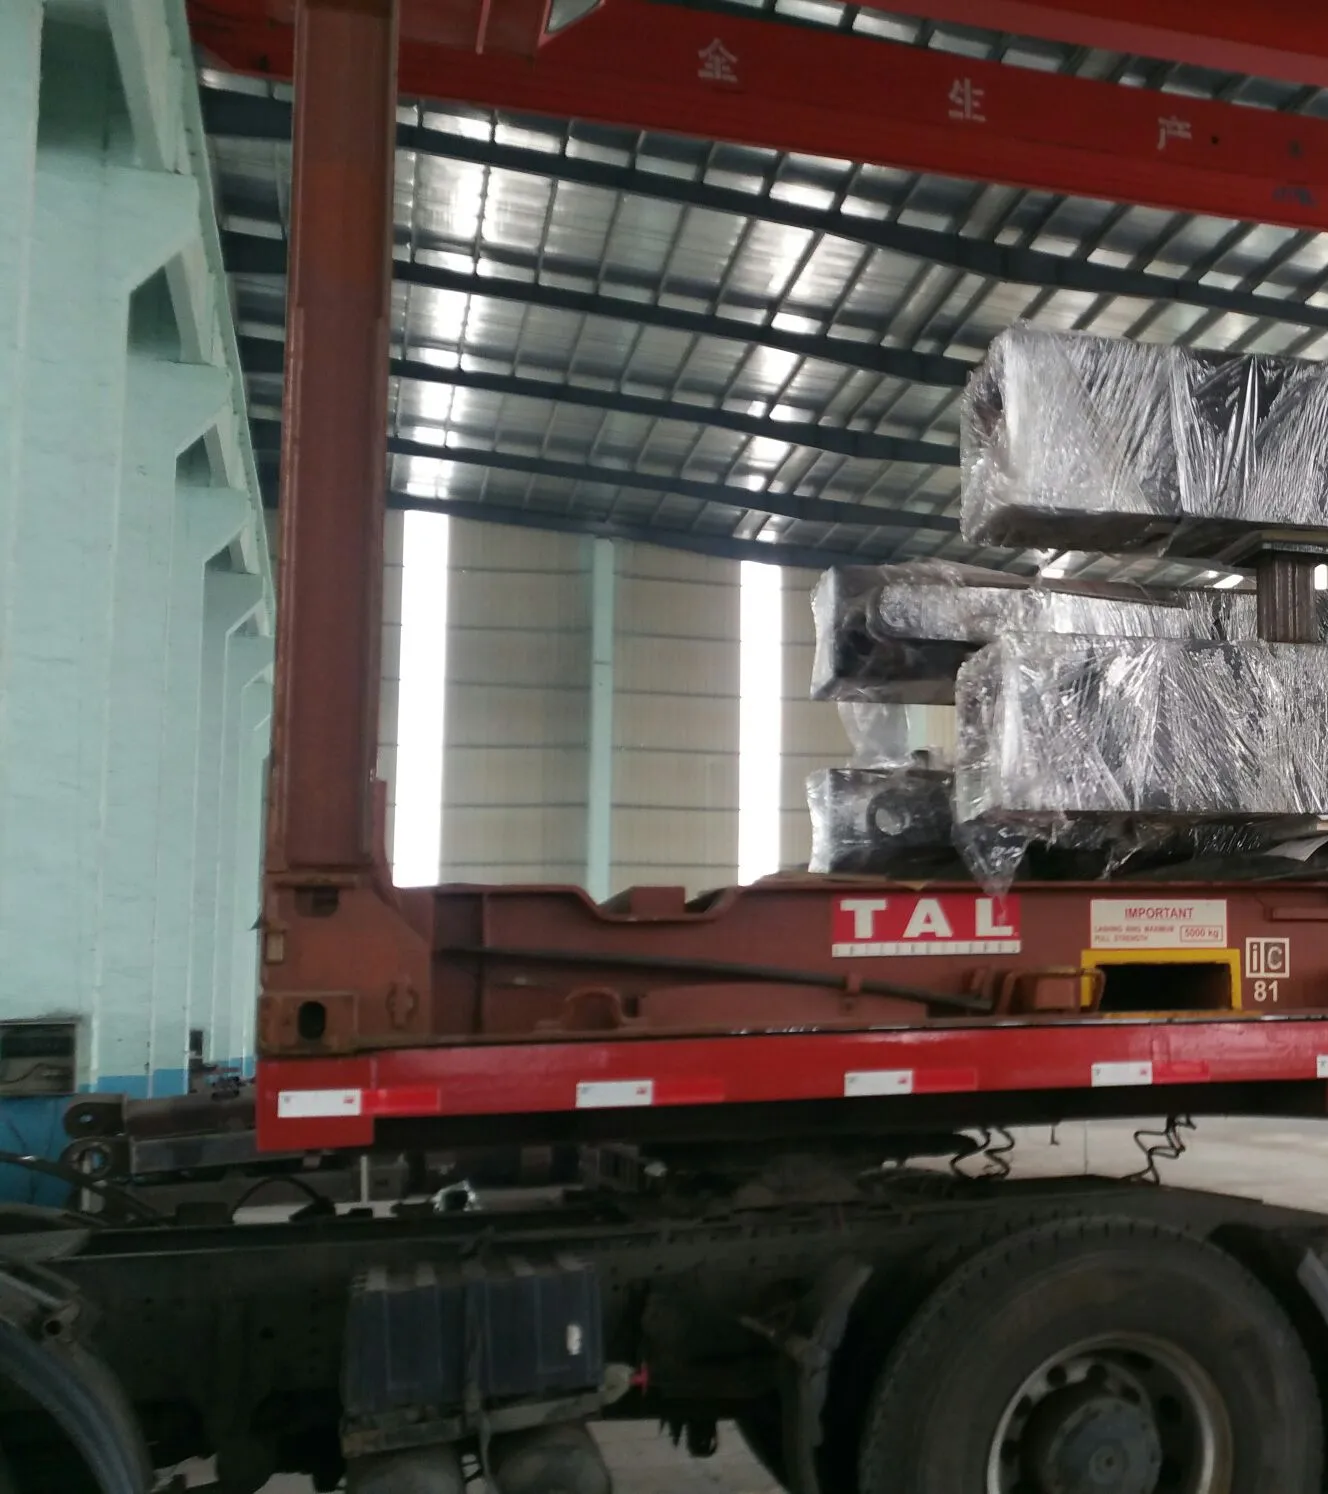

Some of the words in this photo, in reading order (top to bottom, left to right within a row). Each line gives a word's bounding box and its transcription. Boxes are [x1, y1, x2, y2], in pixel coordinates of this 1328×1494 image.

[839, 898, 1014, 939] TAL
[1124, 907, 1195, 920] IMPORTANT
[1185, 928, 1206, 937] 5000
[1253, 980, 1279, 1002] 81
